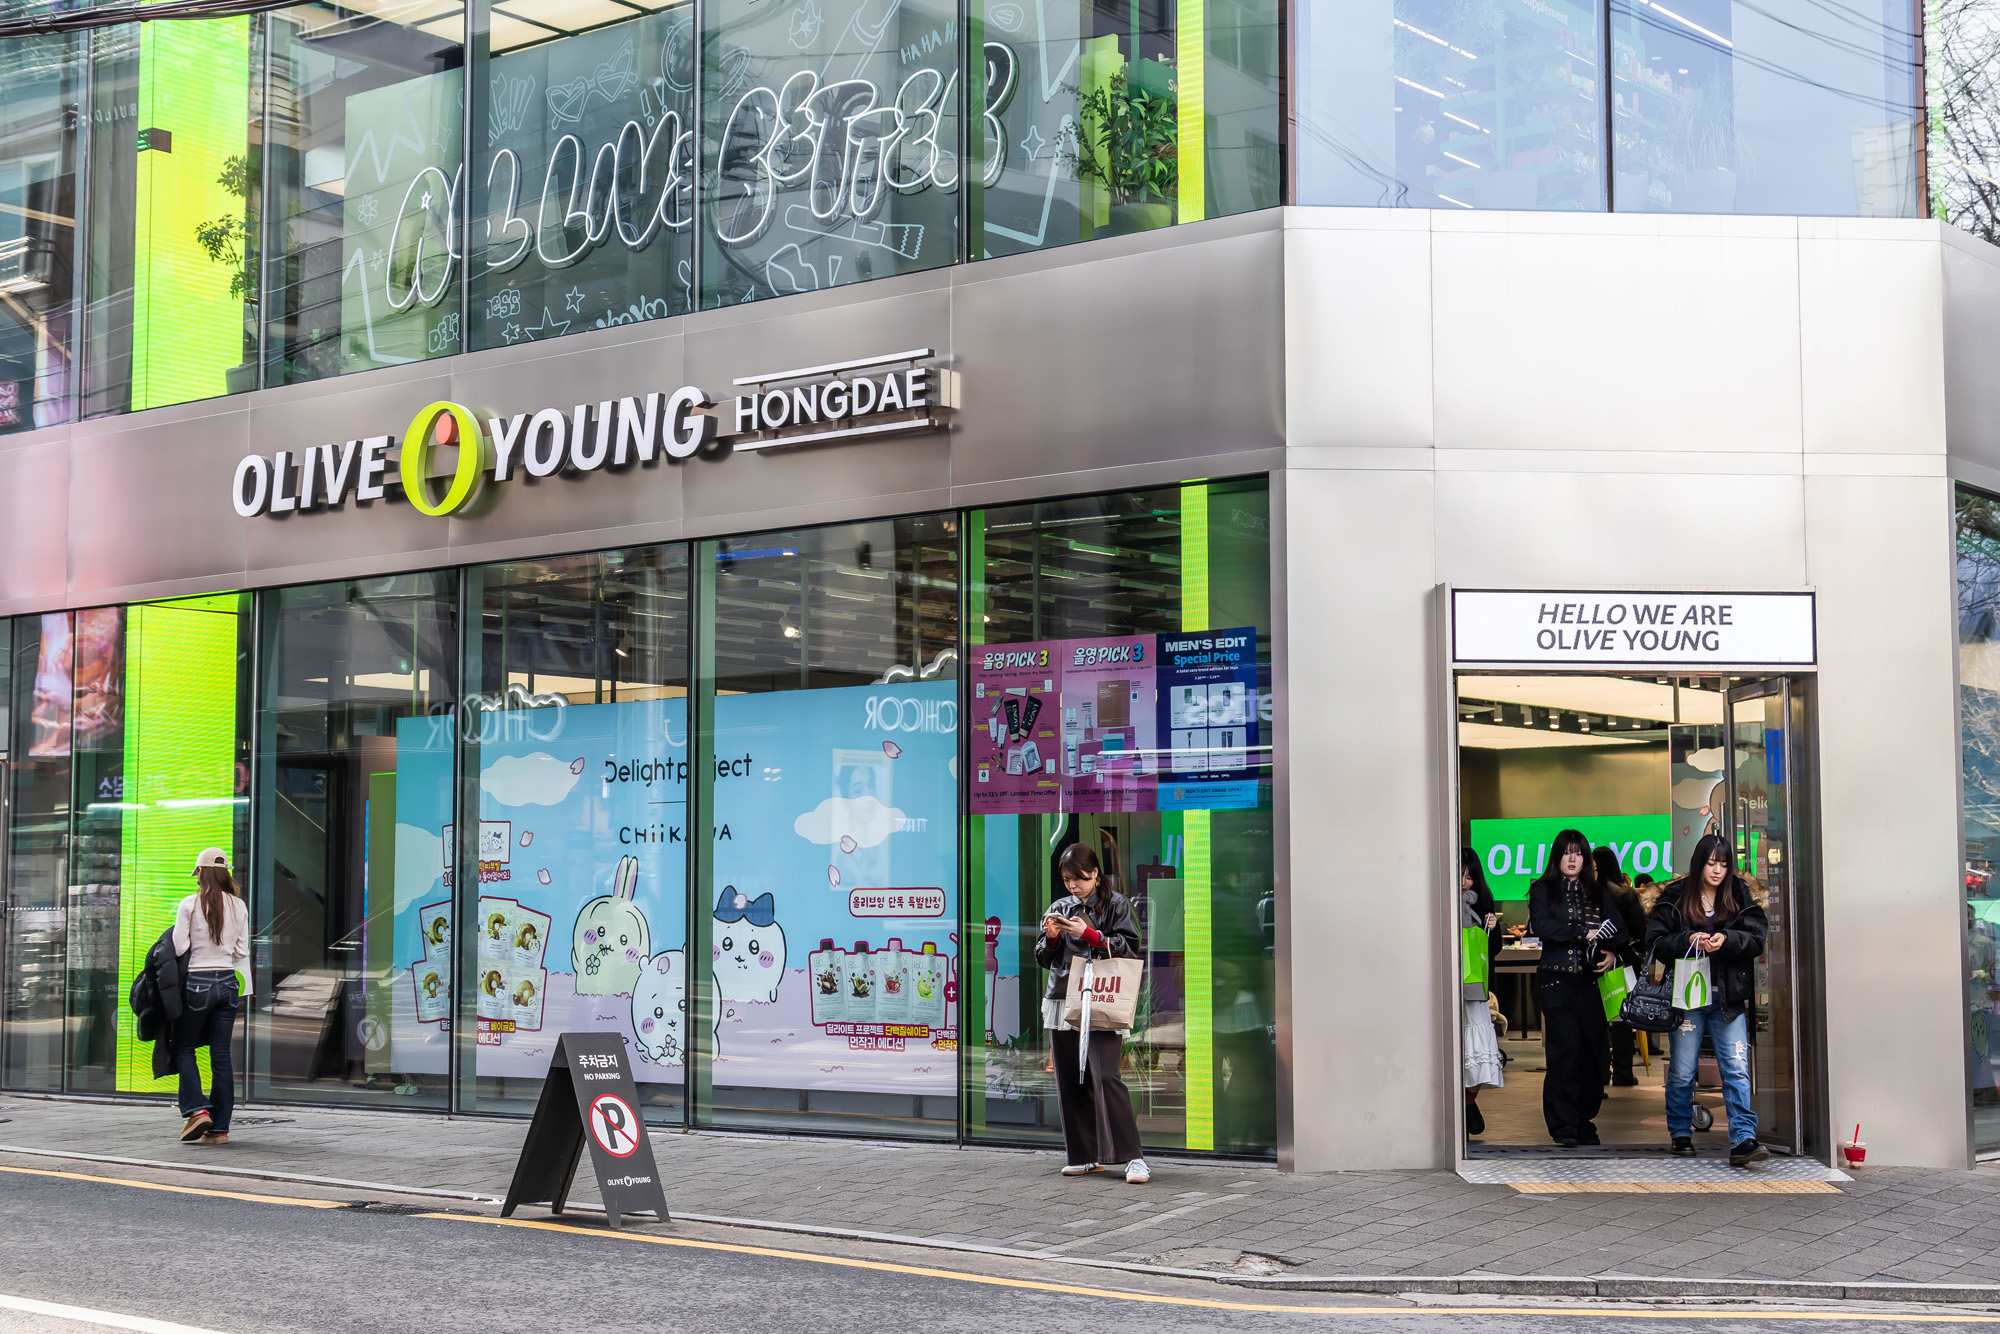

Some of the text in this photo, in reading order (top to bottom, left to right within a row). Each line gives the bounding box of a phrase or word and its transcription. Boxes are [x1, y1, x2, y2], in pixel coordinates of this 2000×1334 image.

[736, 368, 932, 432] HONGDAE
[232, 435, 394, 518] OLIVE
[488, 386, 712, 482] YOUNG
[1537, 603, 1733, 626] HELLO WE ARE
[1165, 637, 1247, 653] MEN'S EDIT
[1536, 629, 1720, 651] OLIVE YOUNG
[1039, 650, 1049, 667] 3
[1132, 644, 1143, 662] 3
[1174, 650, 1240, 667] Special Price
[853, 896, 941, 909] 올리브영 단독 특별한정
[1081, 994, 1115, 1003] 印良品
[827, 1024, 929, 1036] 딜라이트 프로젝트 단백질쉐이크
[478, 1033, 501, 1044] 에디션
[850, 1037, 904, 1049] 먼작귀 에디션
[579, 1054, 619, 1068] 주차금지
[607, 1178, 624, 1186] OLIVE
[632, 1176, 651, 1185] YOUNG
